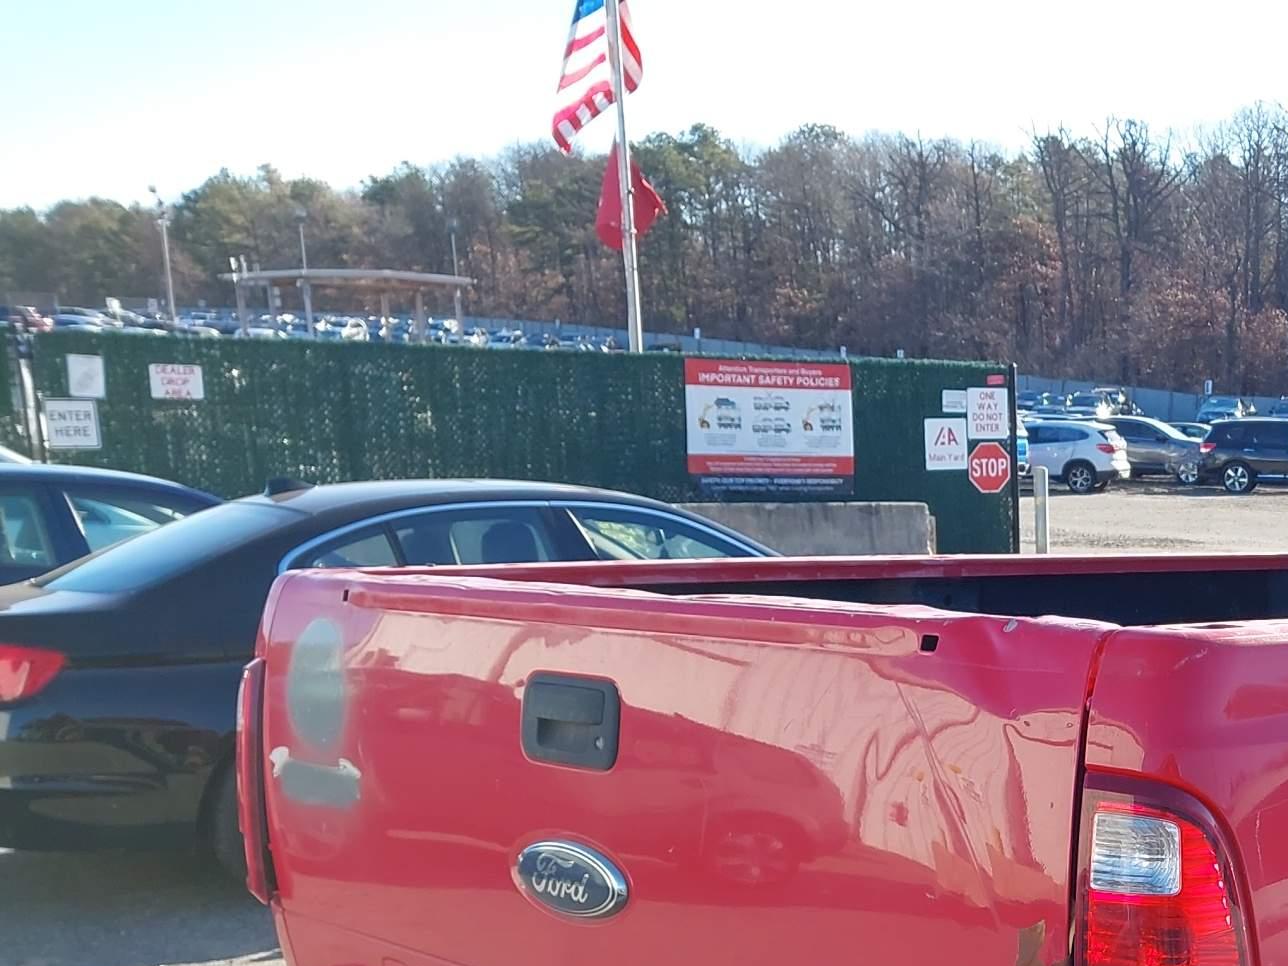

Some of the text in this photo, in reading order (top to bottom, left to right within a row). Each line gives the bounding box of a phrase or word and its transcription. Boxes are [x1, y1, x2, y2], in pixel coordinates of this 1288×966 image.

[155, 365, 195, 375] DEALER
[698, 373, 841, 388] IMPORTANT SAFETY POLICIES
[979, 391, 995, 401] ONE
[976, 402, 998, 411] WAY
[50, 410, 92, 421] ENTER
[972, 412, 1002, 421] DO NOT
[55, 426, 91, 437] HERE
[975, 423, 1000, 433] ENTER
[972, 458, 1007, 477] STOP
[532, 852, 591, 904] Ford
